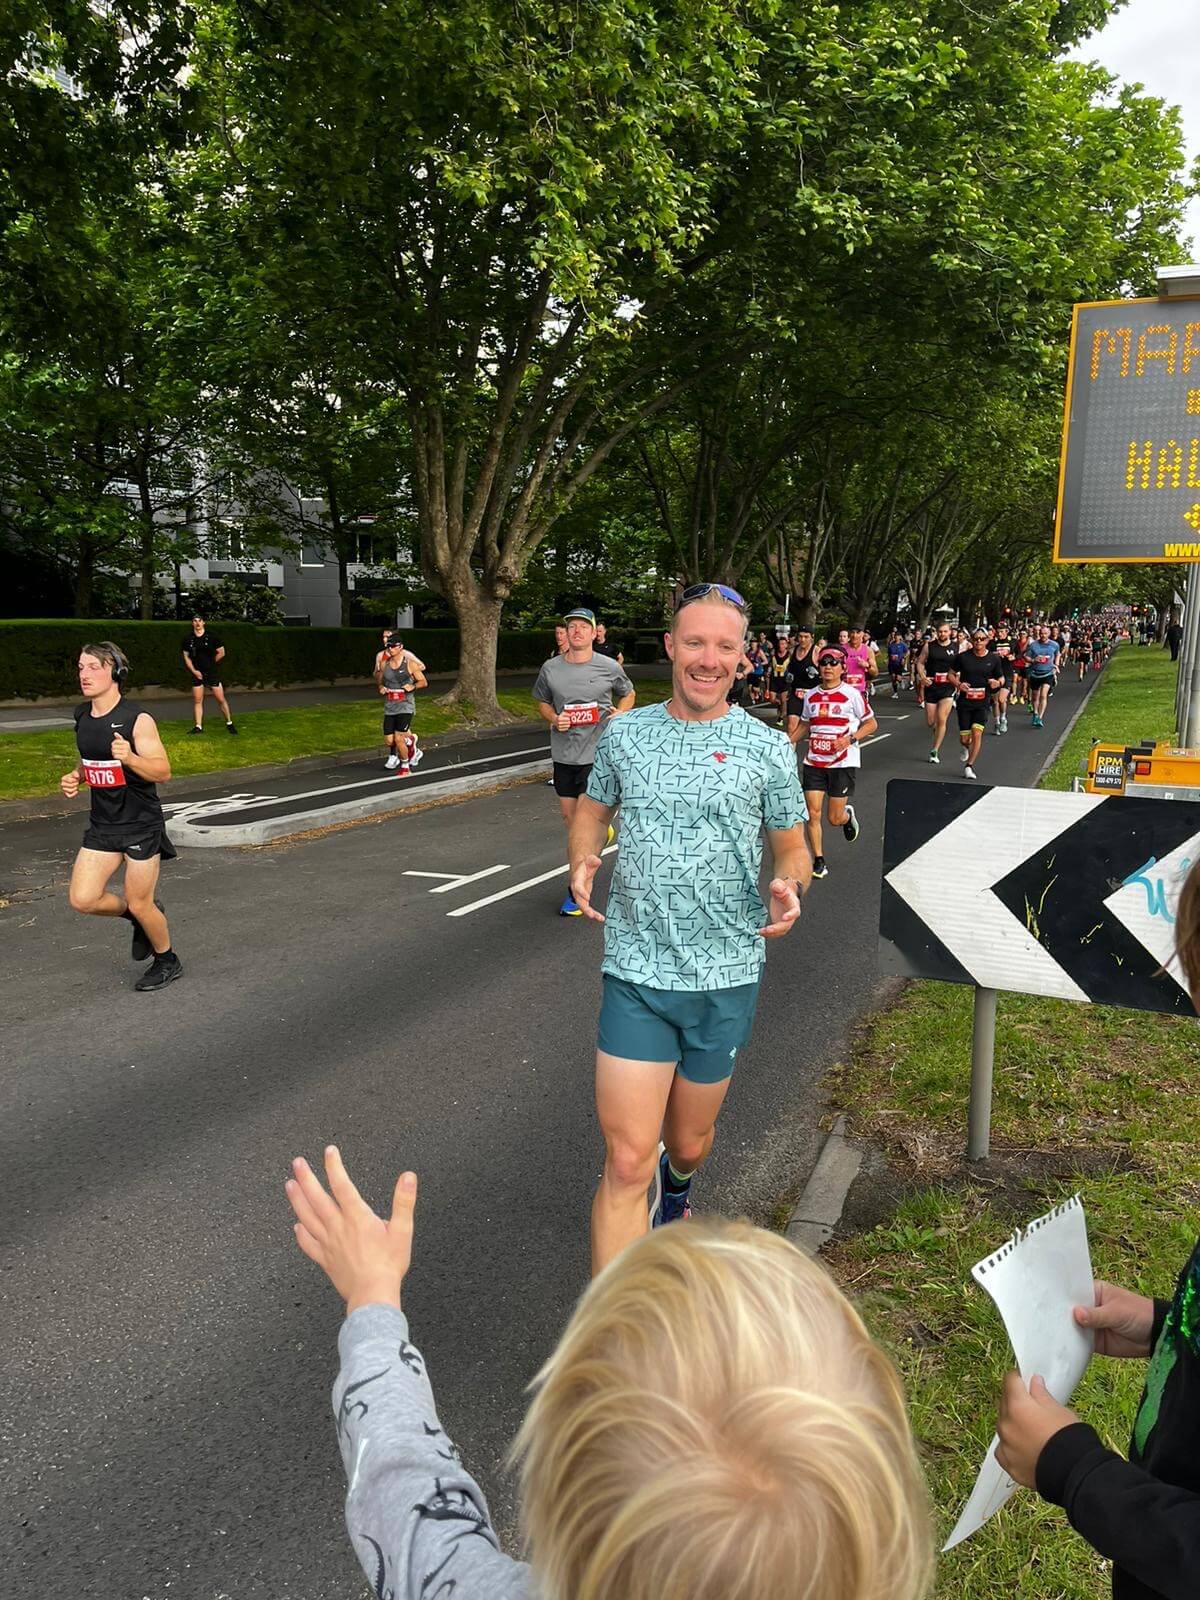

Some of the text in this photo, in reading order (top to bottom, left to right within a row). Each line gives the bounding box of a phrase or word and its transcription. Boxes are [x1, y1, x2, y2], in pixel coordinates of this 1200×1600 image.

[1098, 756, 1122, 766] RPM
[1098, 766, 1120, 776] HIRE
[88, 769, 115, 785] 5176
